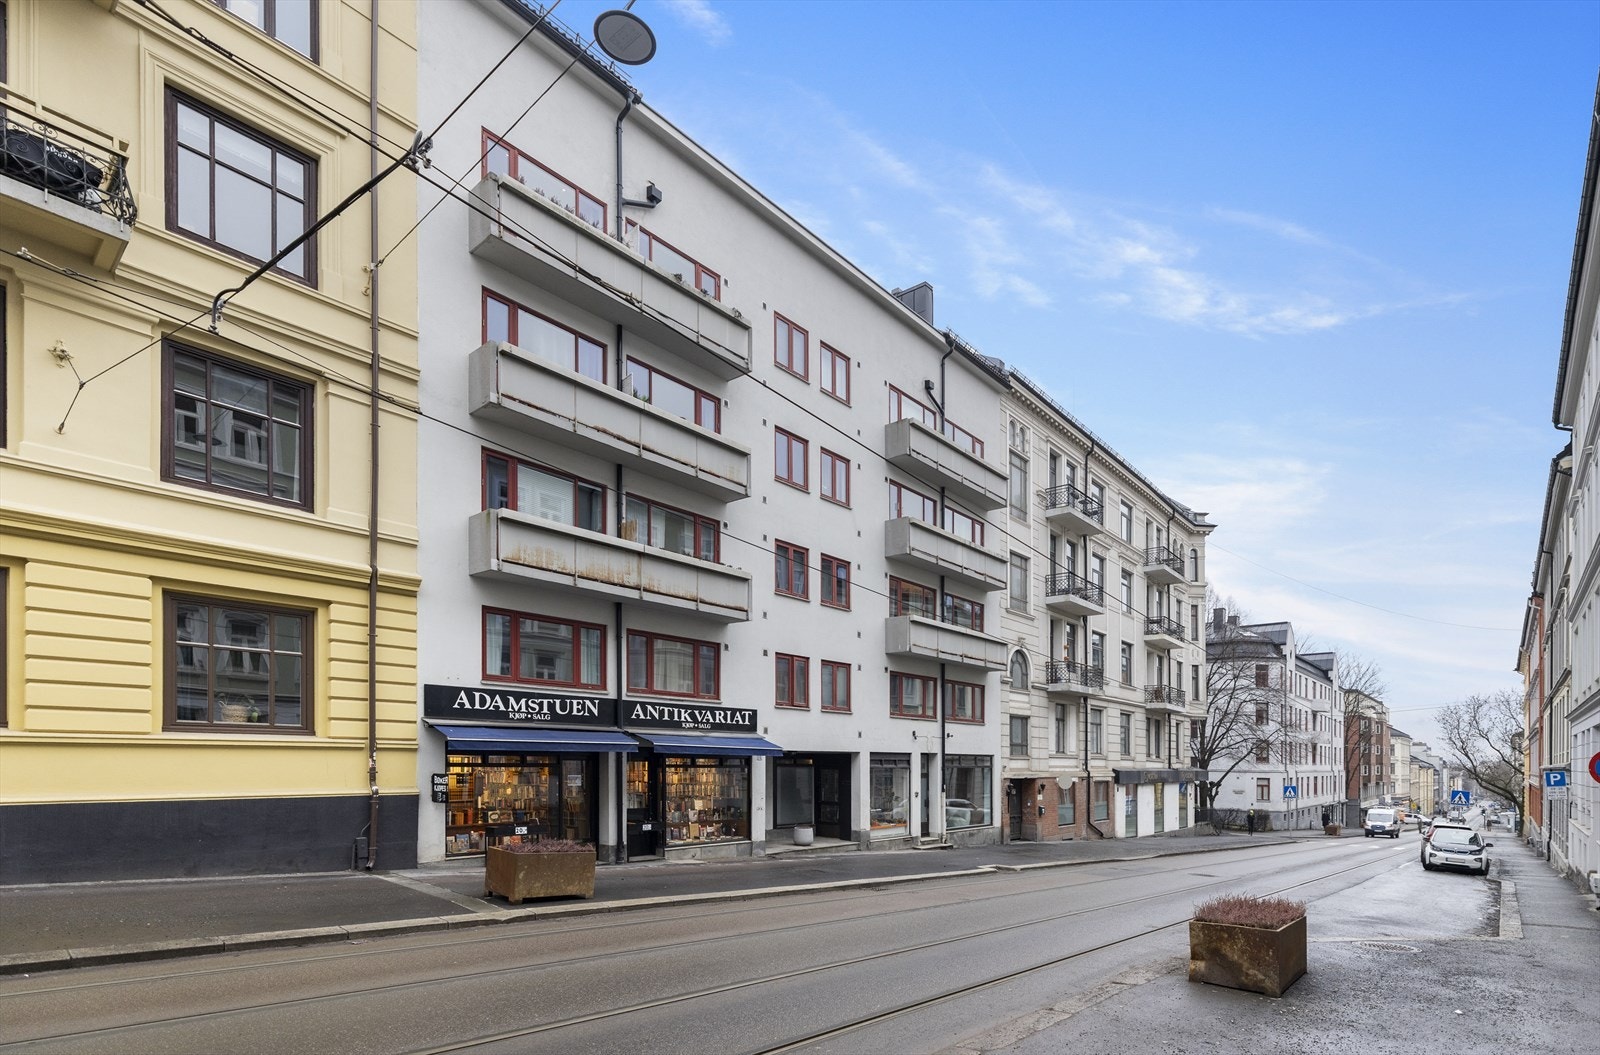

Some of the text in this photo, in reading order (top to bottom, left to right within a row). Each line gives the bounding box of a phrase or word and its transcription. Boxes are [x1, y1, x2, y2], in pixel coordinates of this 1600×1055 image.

[452, 689, 600, 717] ADAMSTUEN
[508, 712, 527, 720] KJØP
[630, 703, 753, 725] ANTIKVARIAT
[1550, 773, 1561, 785] P
